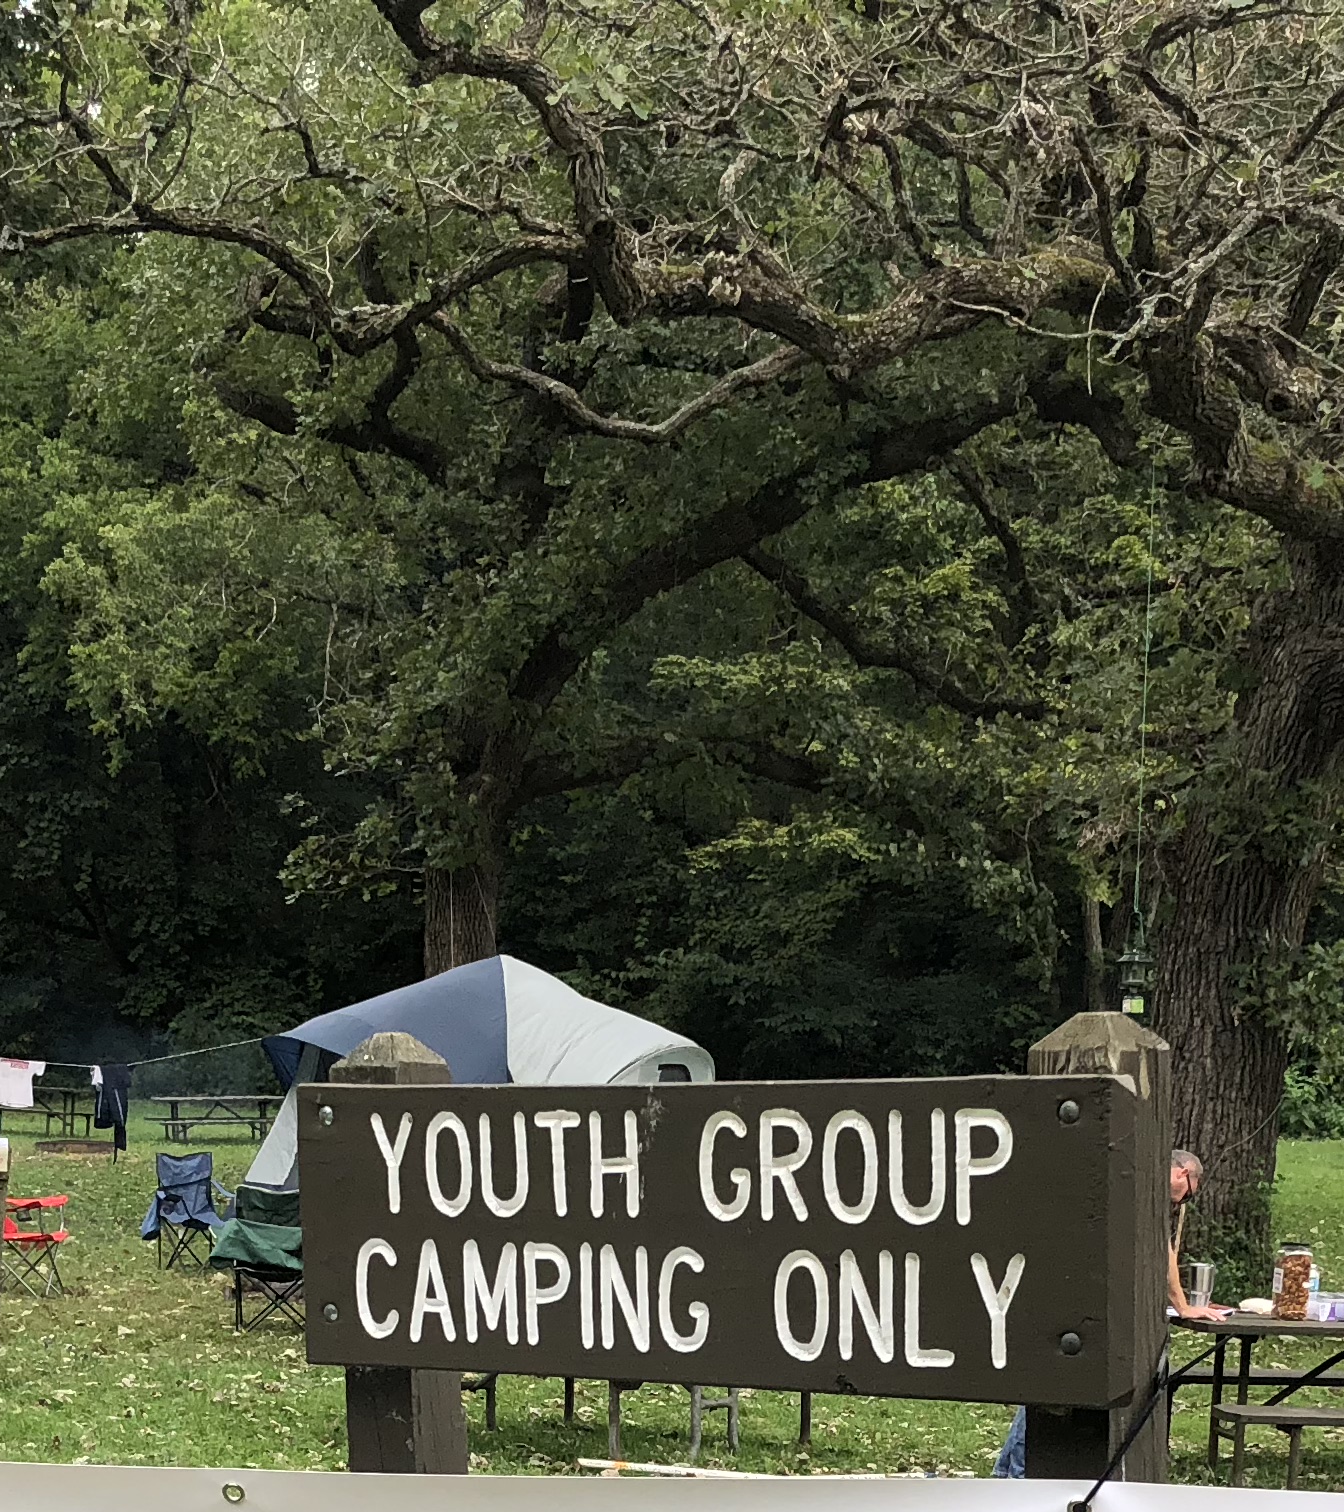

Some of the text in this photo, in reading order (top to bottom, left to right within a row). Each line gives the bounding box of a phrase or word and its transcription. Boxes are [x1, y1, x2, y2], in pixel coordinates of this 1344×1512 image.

[369, 1107, 1014, 1227] YOUTH GROUP
[354, 1236, 1027, 1370] CAMPING ONLY
